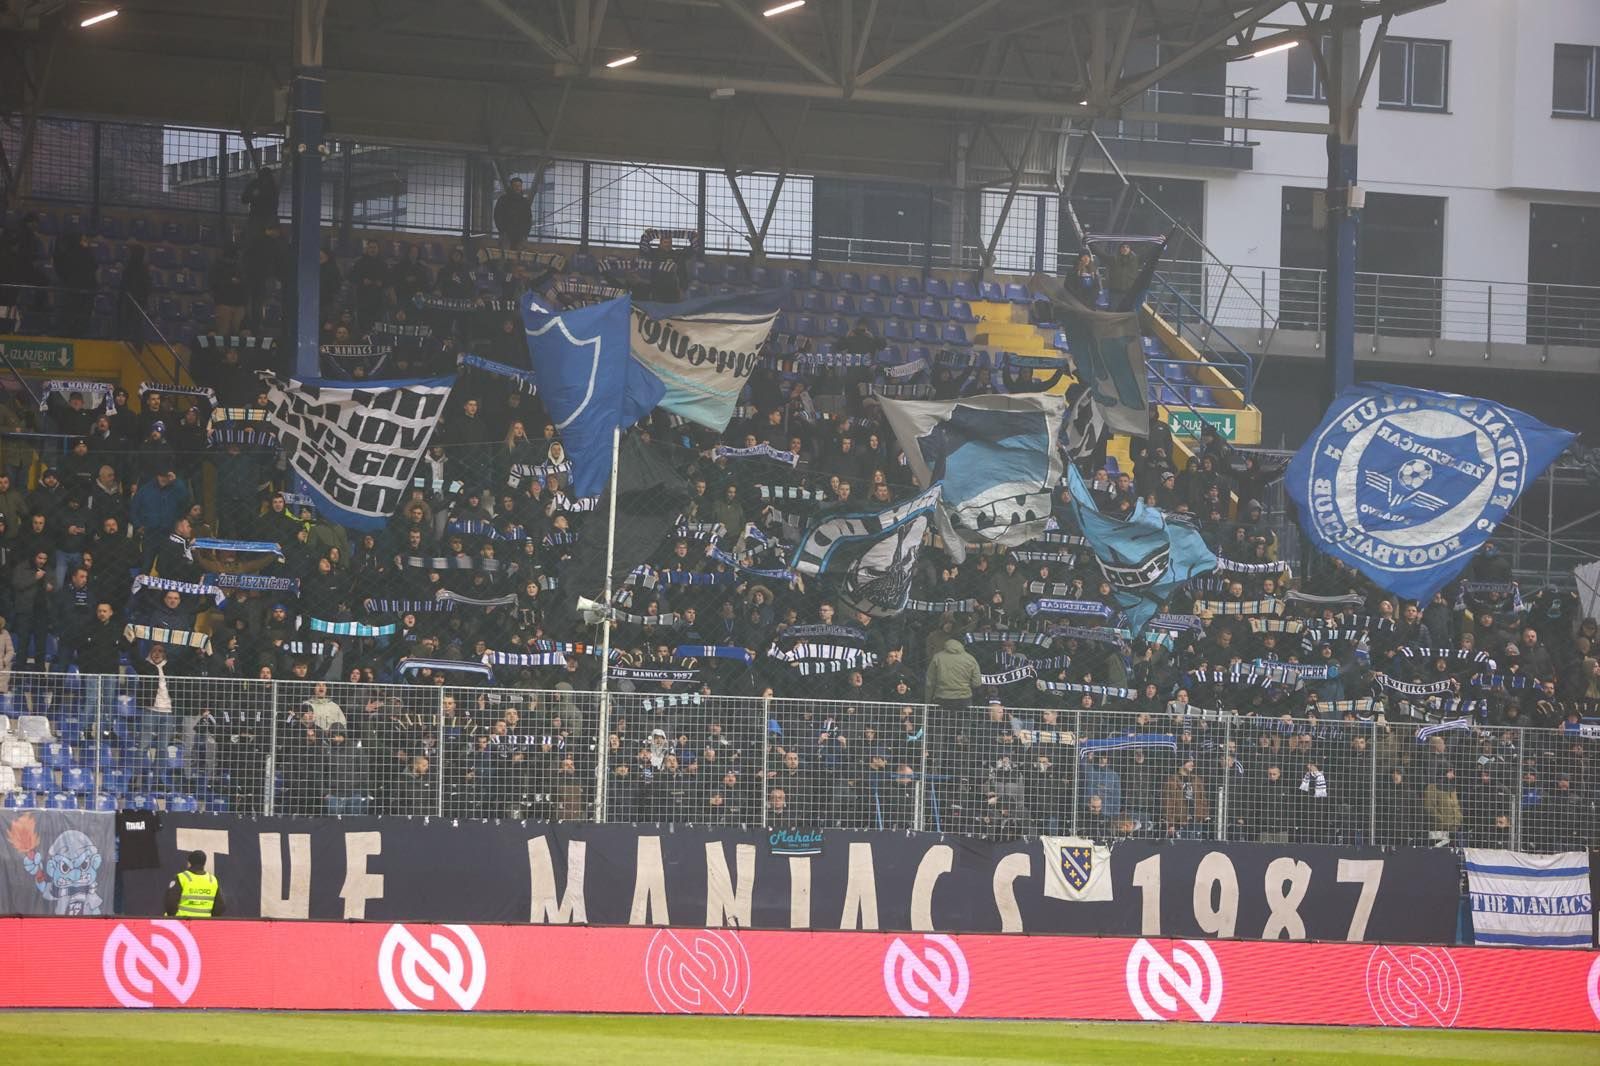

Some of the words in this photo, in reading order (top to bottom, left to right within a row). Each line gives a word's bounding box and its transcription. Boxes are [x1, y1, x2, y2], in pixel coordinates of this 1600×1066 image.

[632, 670, 668, 679] MANIACS
[981, 676, 1007, 685] NIACS
[769, 830, 824, 845] Mahala
[1132, 851, 1385, 941] 1987
[1471, 892, 1509, 912] THE
[1512, 894, 1592, 914] MANIACS
